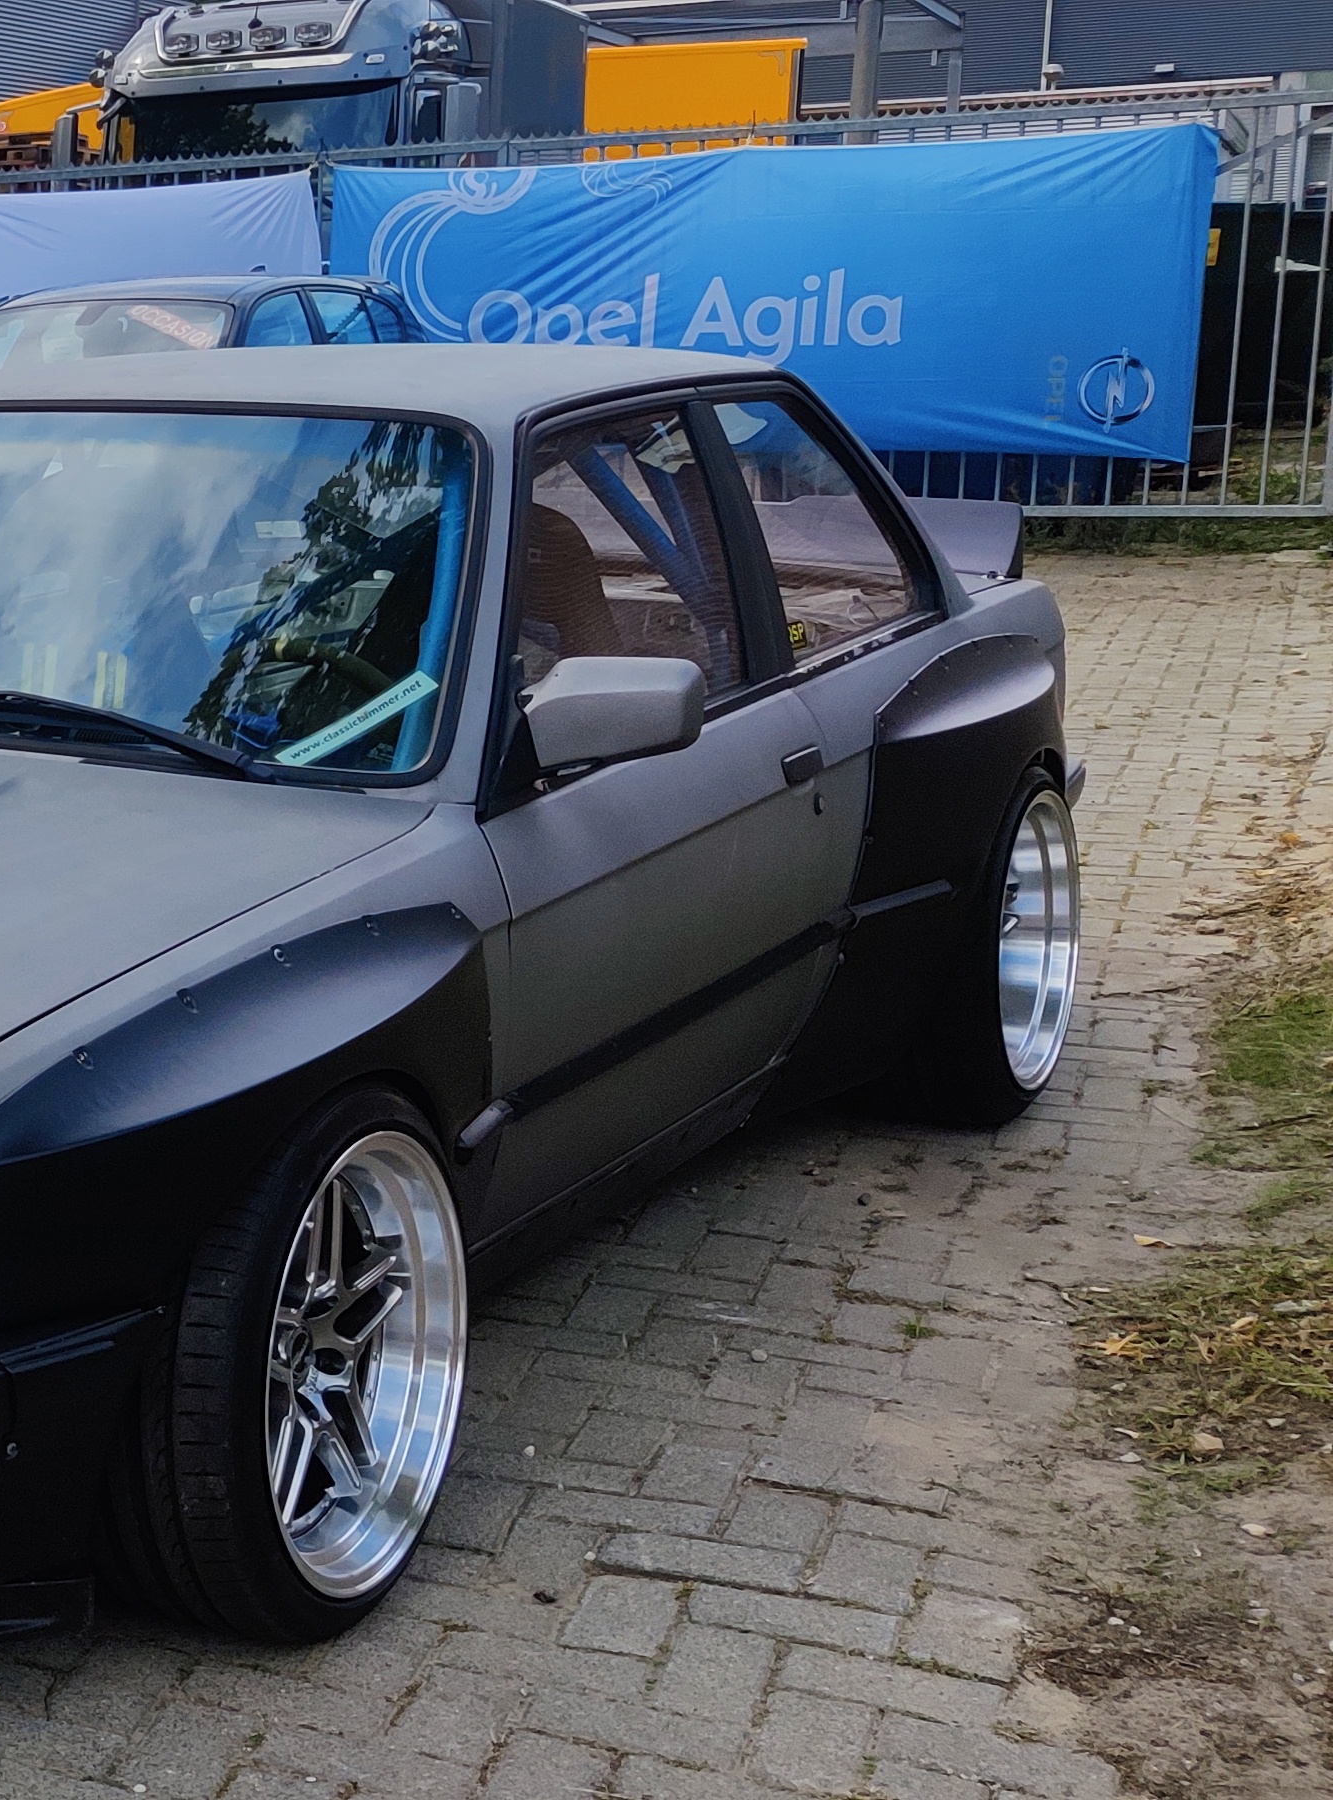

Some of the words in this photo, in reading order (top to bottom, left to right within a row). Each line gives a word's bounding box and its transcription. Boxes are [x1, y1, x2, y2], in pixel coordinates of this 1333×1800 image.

[132, 304, 215, 349] OCCASION
[467, 272, 661, 348] Opel
[679, 267, 904, 366] Agila
[289, 679, 423, 760] www.classicbimmer.net
